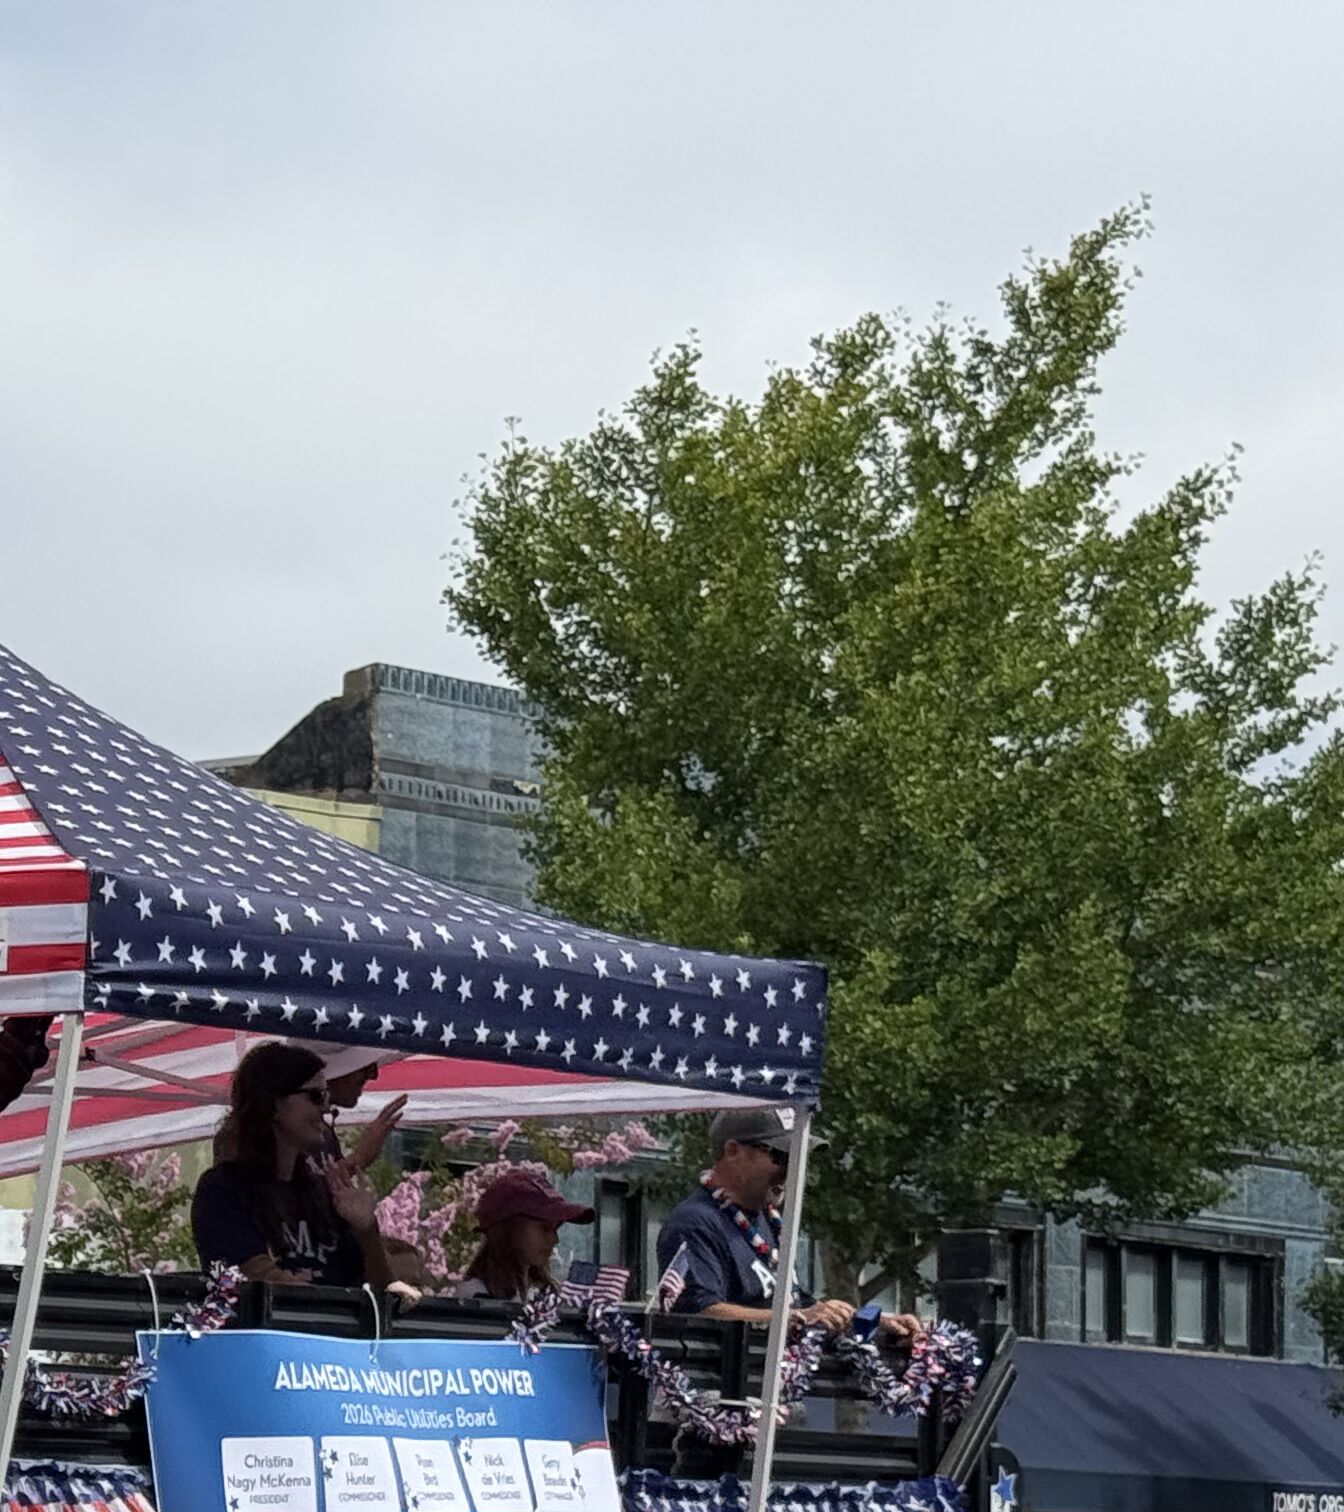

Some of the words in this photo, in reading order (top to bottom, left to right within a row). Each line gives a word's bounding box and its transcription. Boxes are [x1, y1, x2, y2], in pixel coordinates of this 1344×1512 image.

[274, 1361, 362, 1393] ALAMEDA
[362, 1368, 470, 1398] MUNICIPAL
[471, 1369, 536, 1398] POWER
[457, 1407, 498, 1427] Board
[244, 1453, 294, 1469] Christina
[227, 1475, 256, 1492] Nagy
